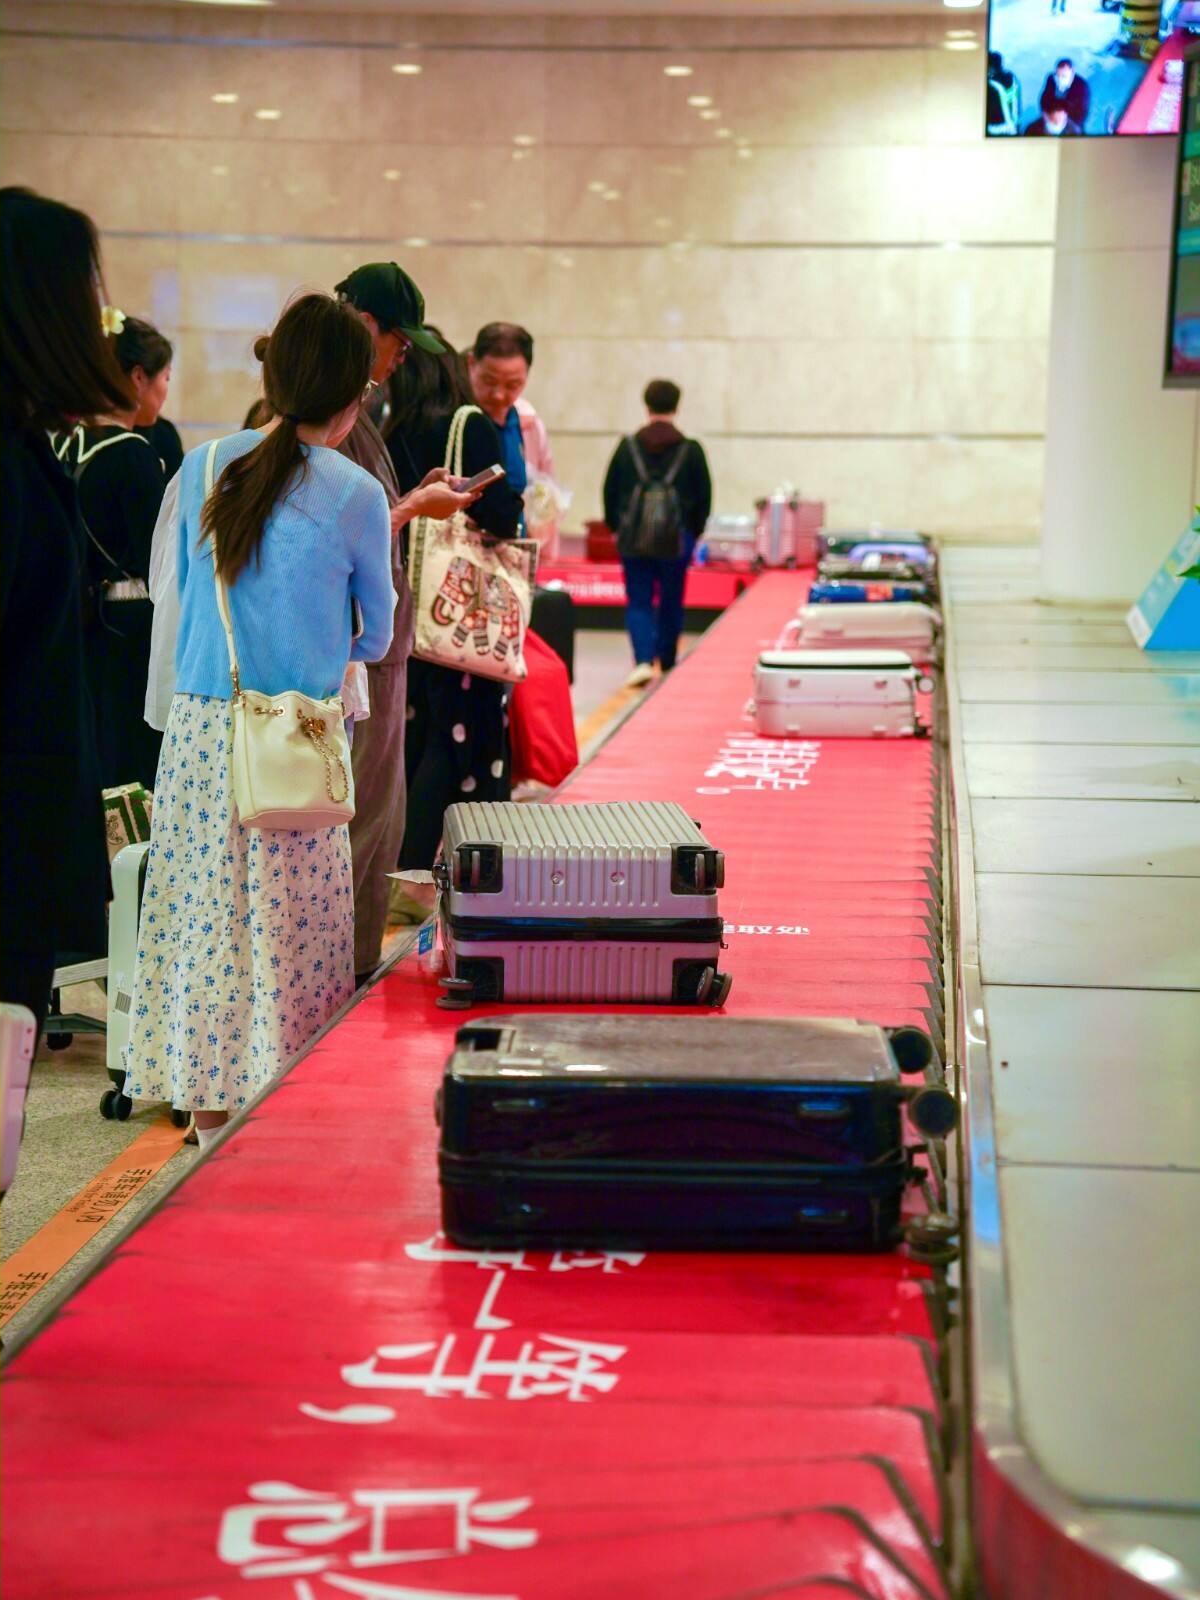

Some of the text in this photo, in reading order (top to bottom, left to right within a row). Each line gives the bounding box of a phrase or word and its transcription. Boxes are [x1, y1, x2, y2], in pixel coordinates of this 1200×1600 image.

[75, 1168, 153, 1223] 手推车请勿入内
